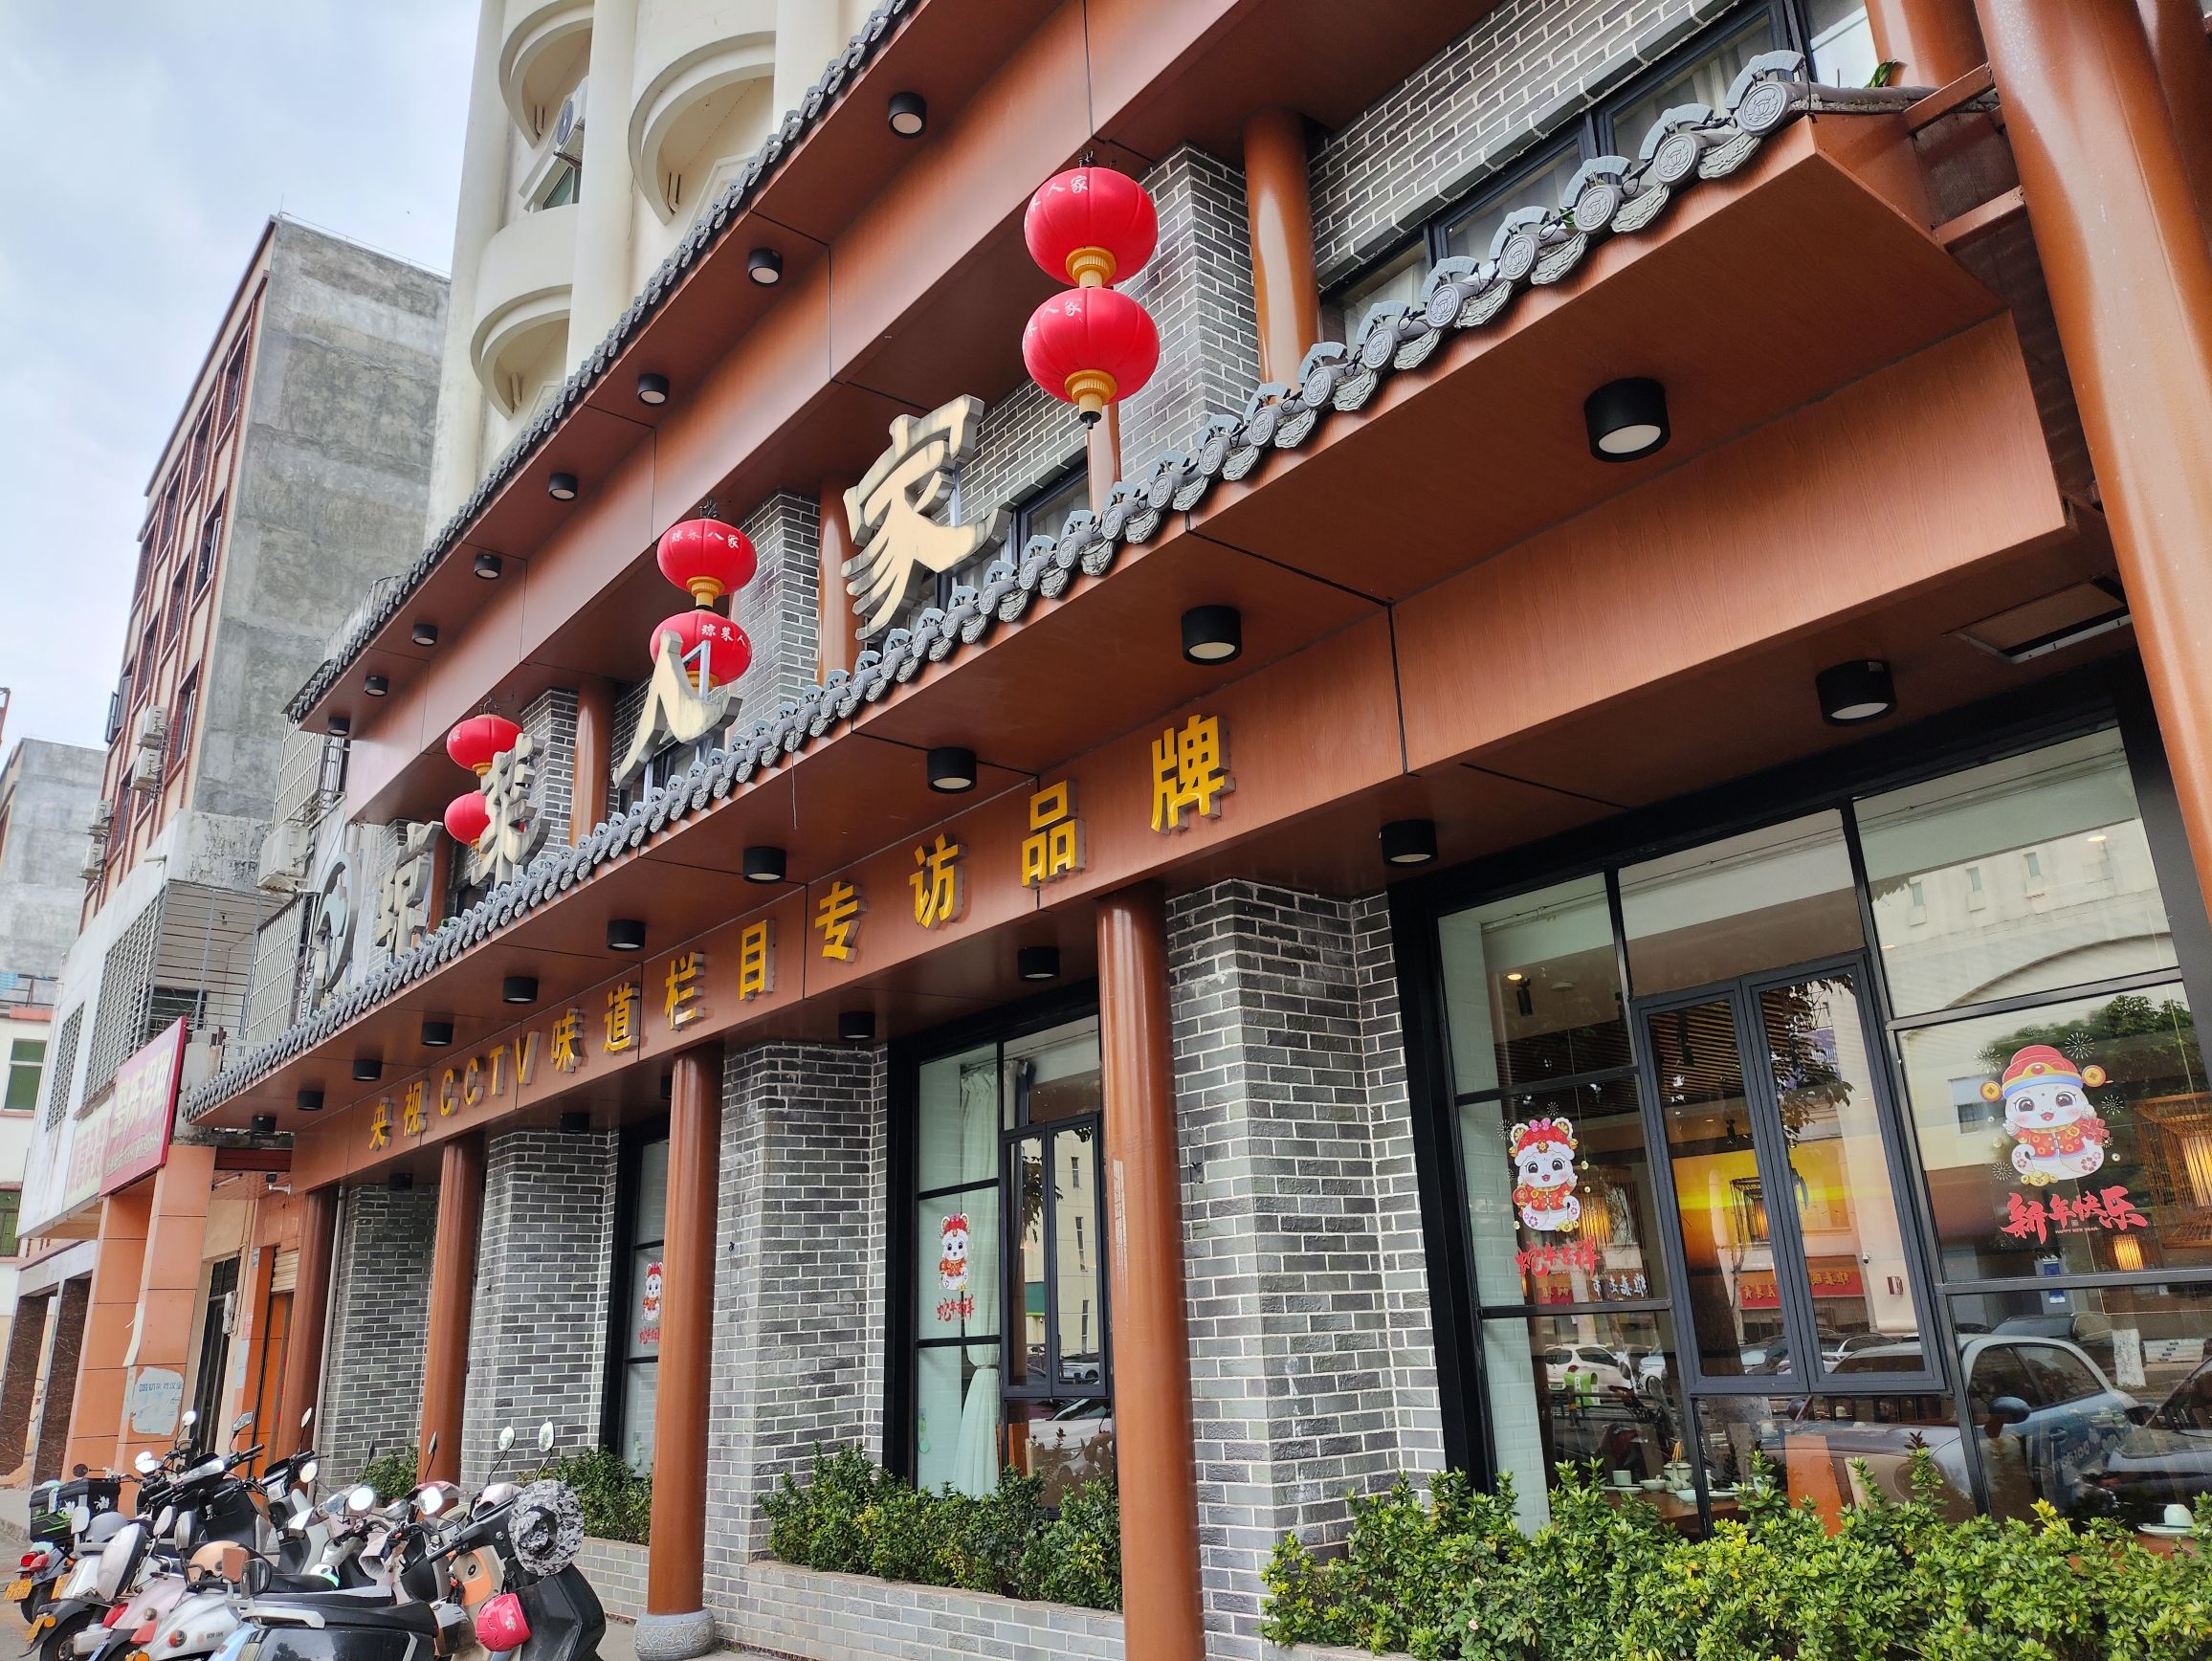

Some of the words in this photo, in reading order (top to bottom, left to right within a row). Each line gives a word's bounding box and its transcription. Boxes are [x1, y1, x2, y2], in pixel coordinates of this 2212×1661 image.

[701, 624, 751, 656] 琼菜人
[2001, 1185, 2148, 1245] 新年快乐
[1515, 1234, 1602, 1279] 蛇年吉祥
